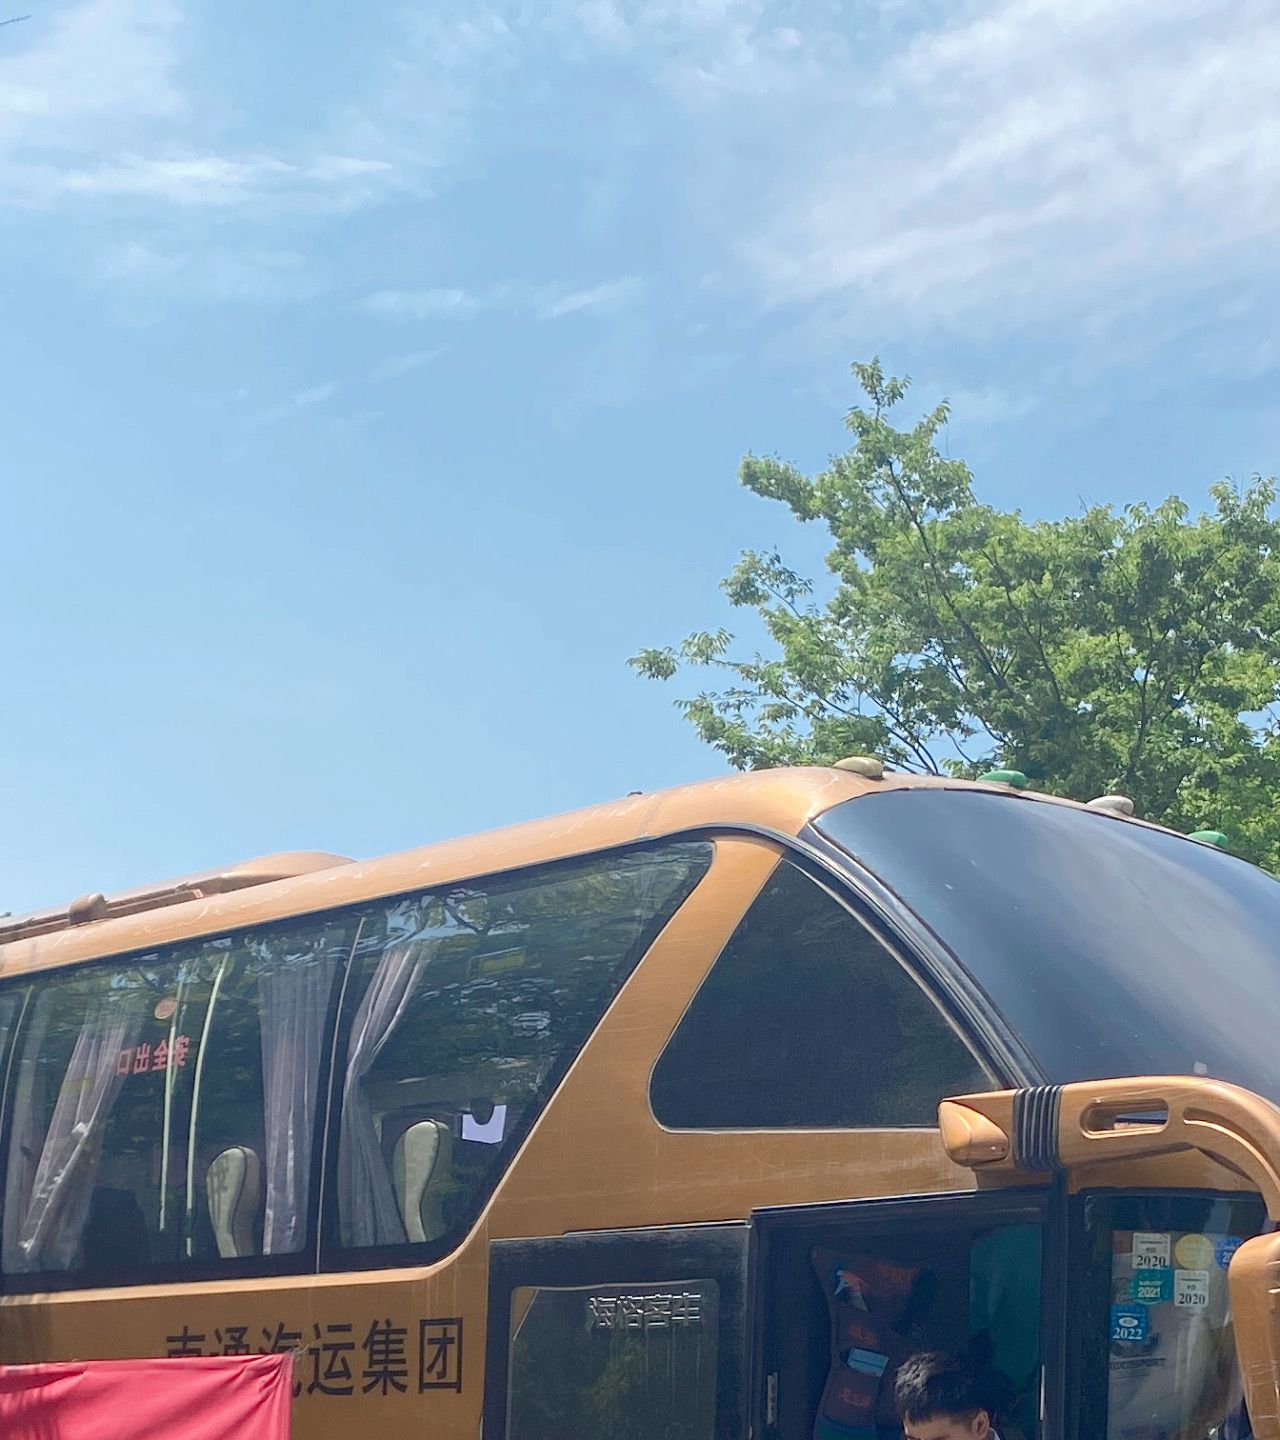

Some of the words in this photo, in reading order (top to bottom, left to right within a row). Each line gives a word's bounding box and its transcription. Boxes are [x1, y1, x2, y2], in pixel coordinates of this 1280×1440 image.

[1136, 1254, 1167, 1268] 2020
[1177, 1292, 1206, 1305] 2020
[1112, 1326, 1143, 1340] 2022
